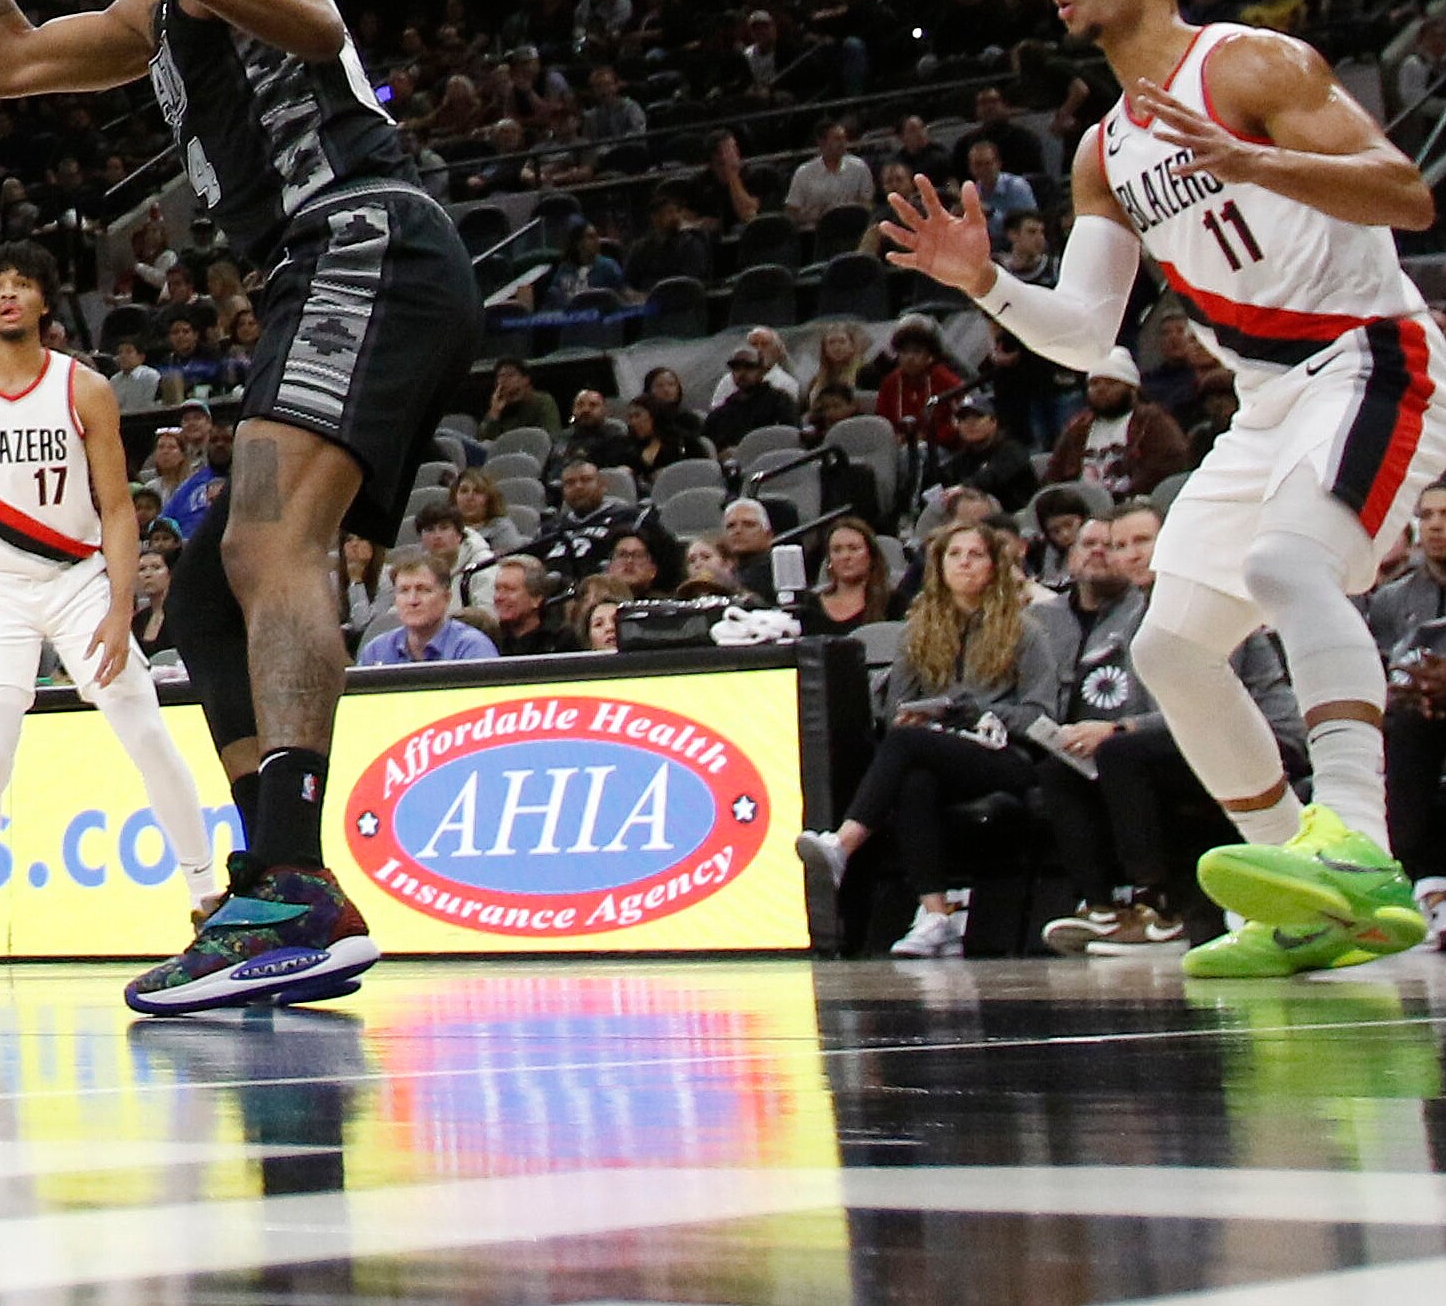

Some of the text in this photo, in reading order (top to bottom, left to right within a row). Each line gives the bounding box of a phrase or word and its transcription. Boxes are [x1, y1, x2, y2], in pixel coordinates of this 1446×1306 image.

[1202, 200, 1265, 272] 11
[33, 466, 68, 507] 17
[382, 700, 730, 800] Affordable Health
[416, 760, 675, 859] AHIA
[373, 845, 734, 931] Insurance Agency
